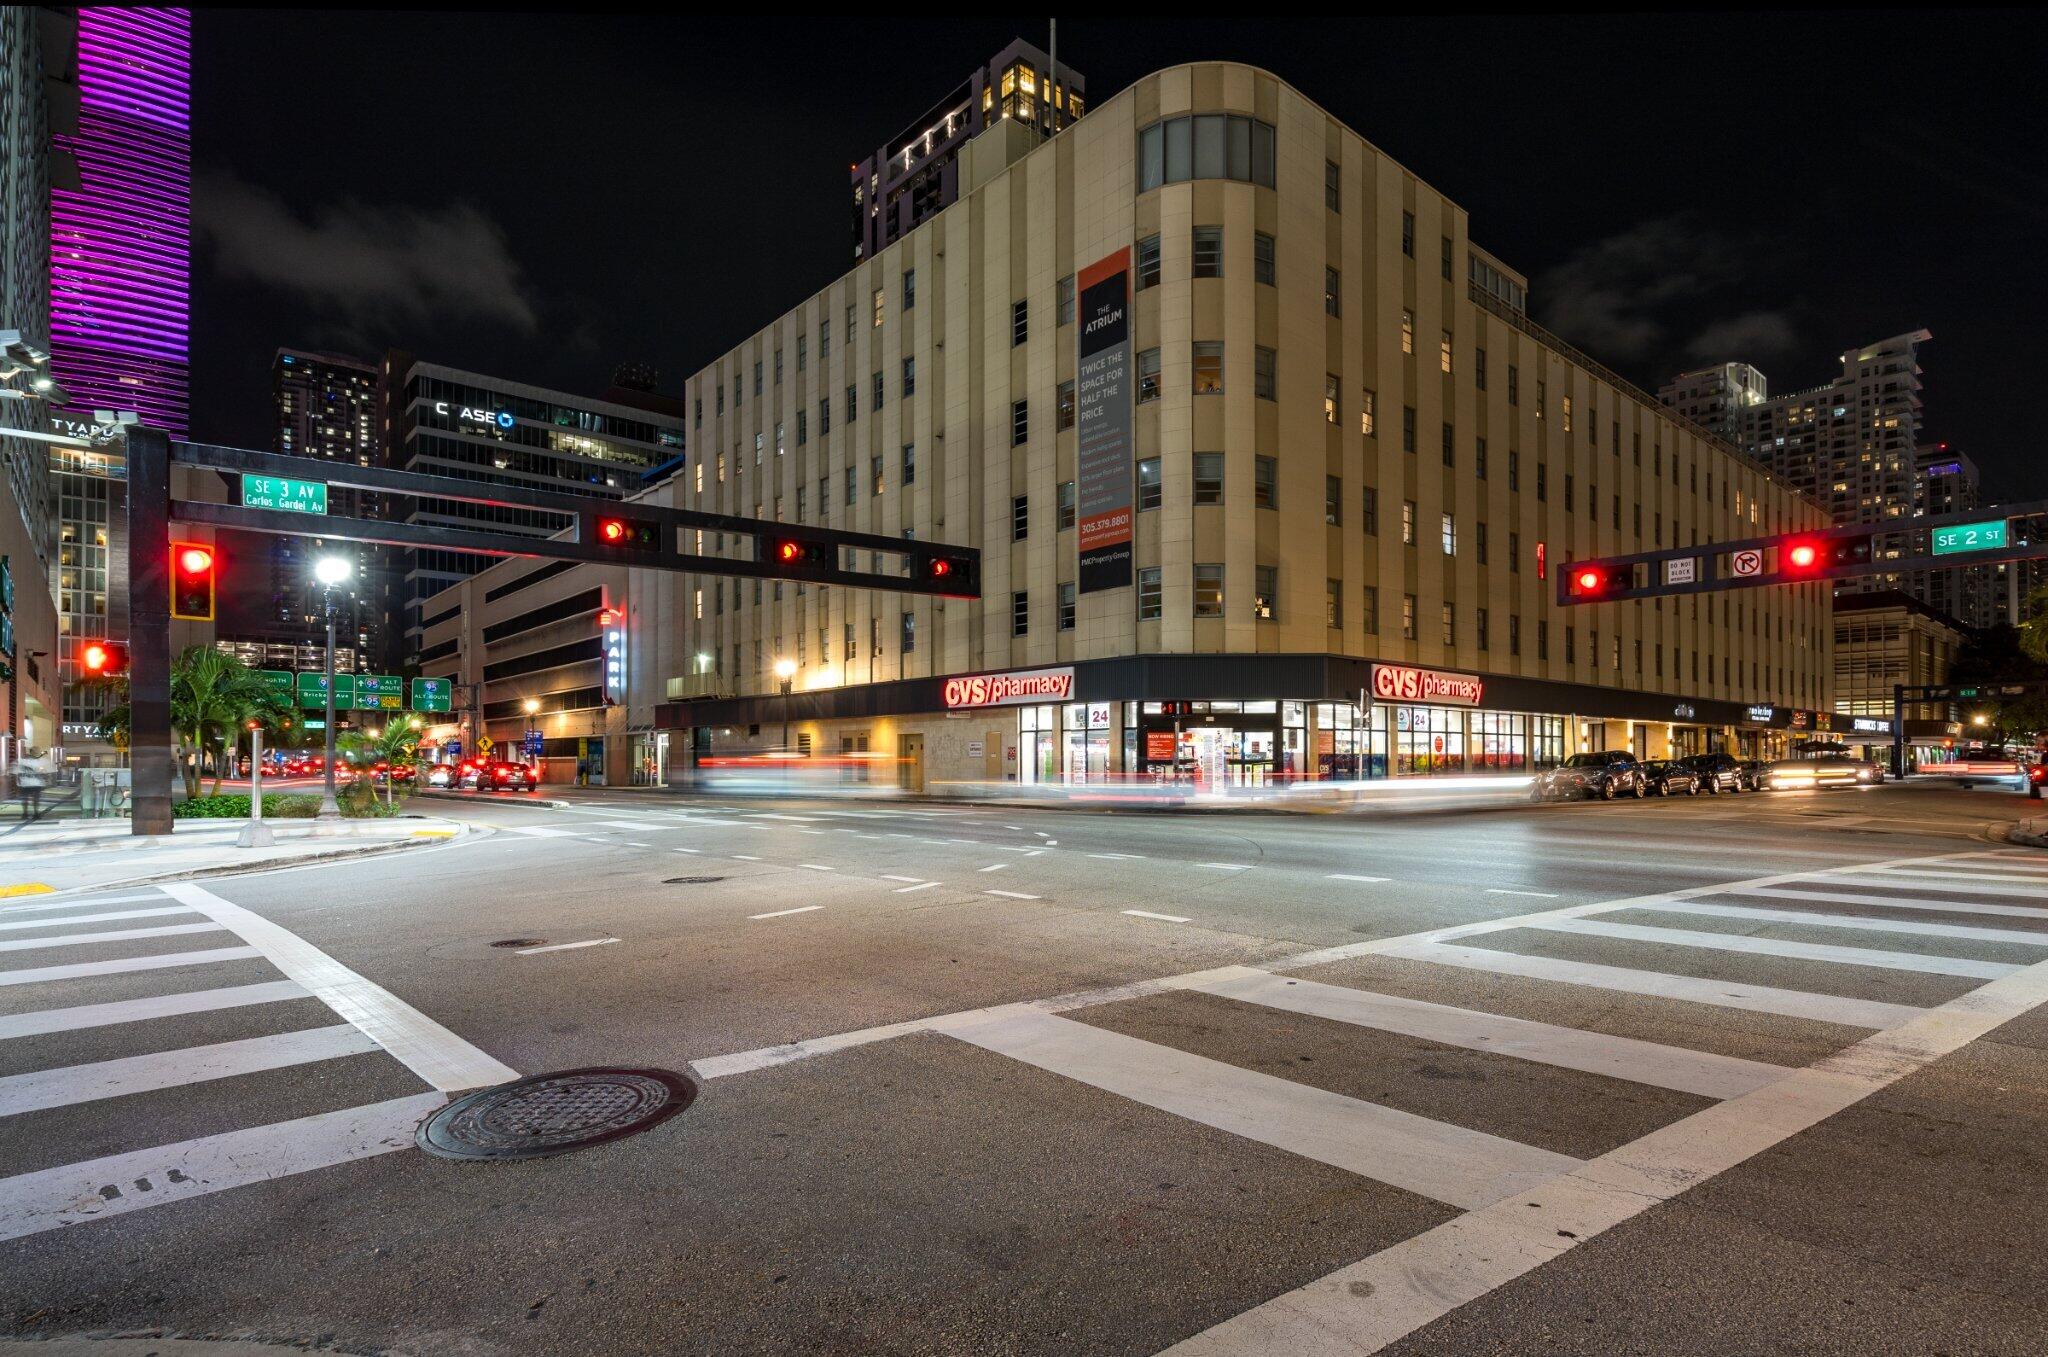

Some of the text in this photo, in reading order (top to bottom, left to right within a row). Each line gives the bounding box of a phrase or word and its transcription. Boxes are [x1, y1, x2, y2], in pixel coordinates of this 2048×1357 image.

[1097, 304, 1110, 316] THE
[1086, 308, 1122, 335] ATRIUM
[1081, 351, 1123, 376] TWICE THE
[1081, 367, 1123, 392] SPACE FOR
[1081, 384, 1118, 407] HALF THE
[436, 402, 496, 424] CASE
[1081, 405, 1104, 422] PRICE
[255, 479, 315, 499] SE 3 AV
[246, 493, 323, 512] Carlos Gardel Av
[1081, 514, 1129, 535] 305.379.8801
[1938, 530, 2000, 546] SE 2 ST
[608, 631, 620, 688] PARK
[366, 681, 378, 689] 95
[425, 683, 437, 692] 95
[366, 697, 378, 706] 95
[1093, 710, 1108, 723] 24
[1415, 714, 1425, 726] 24
